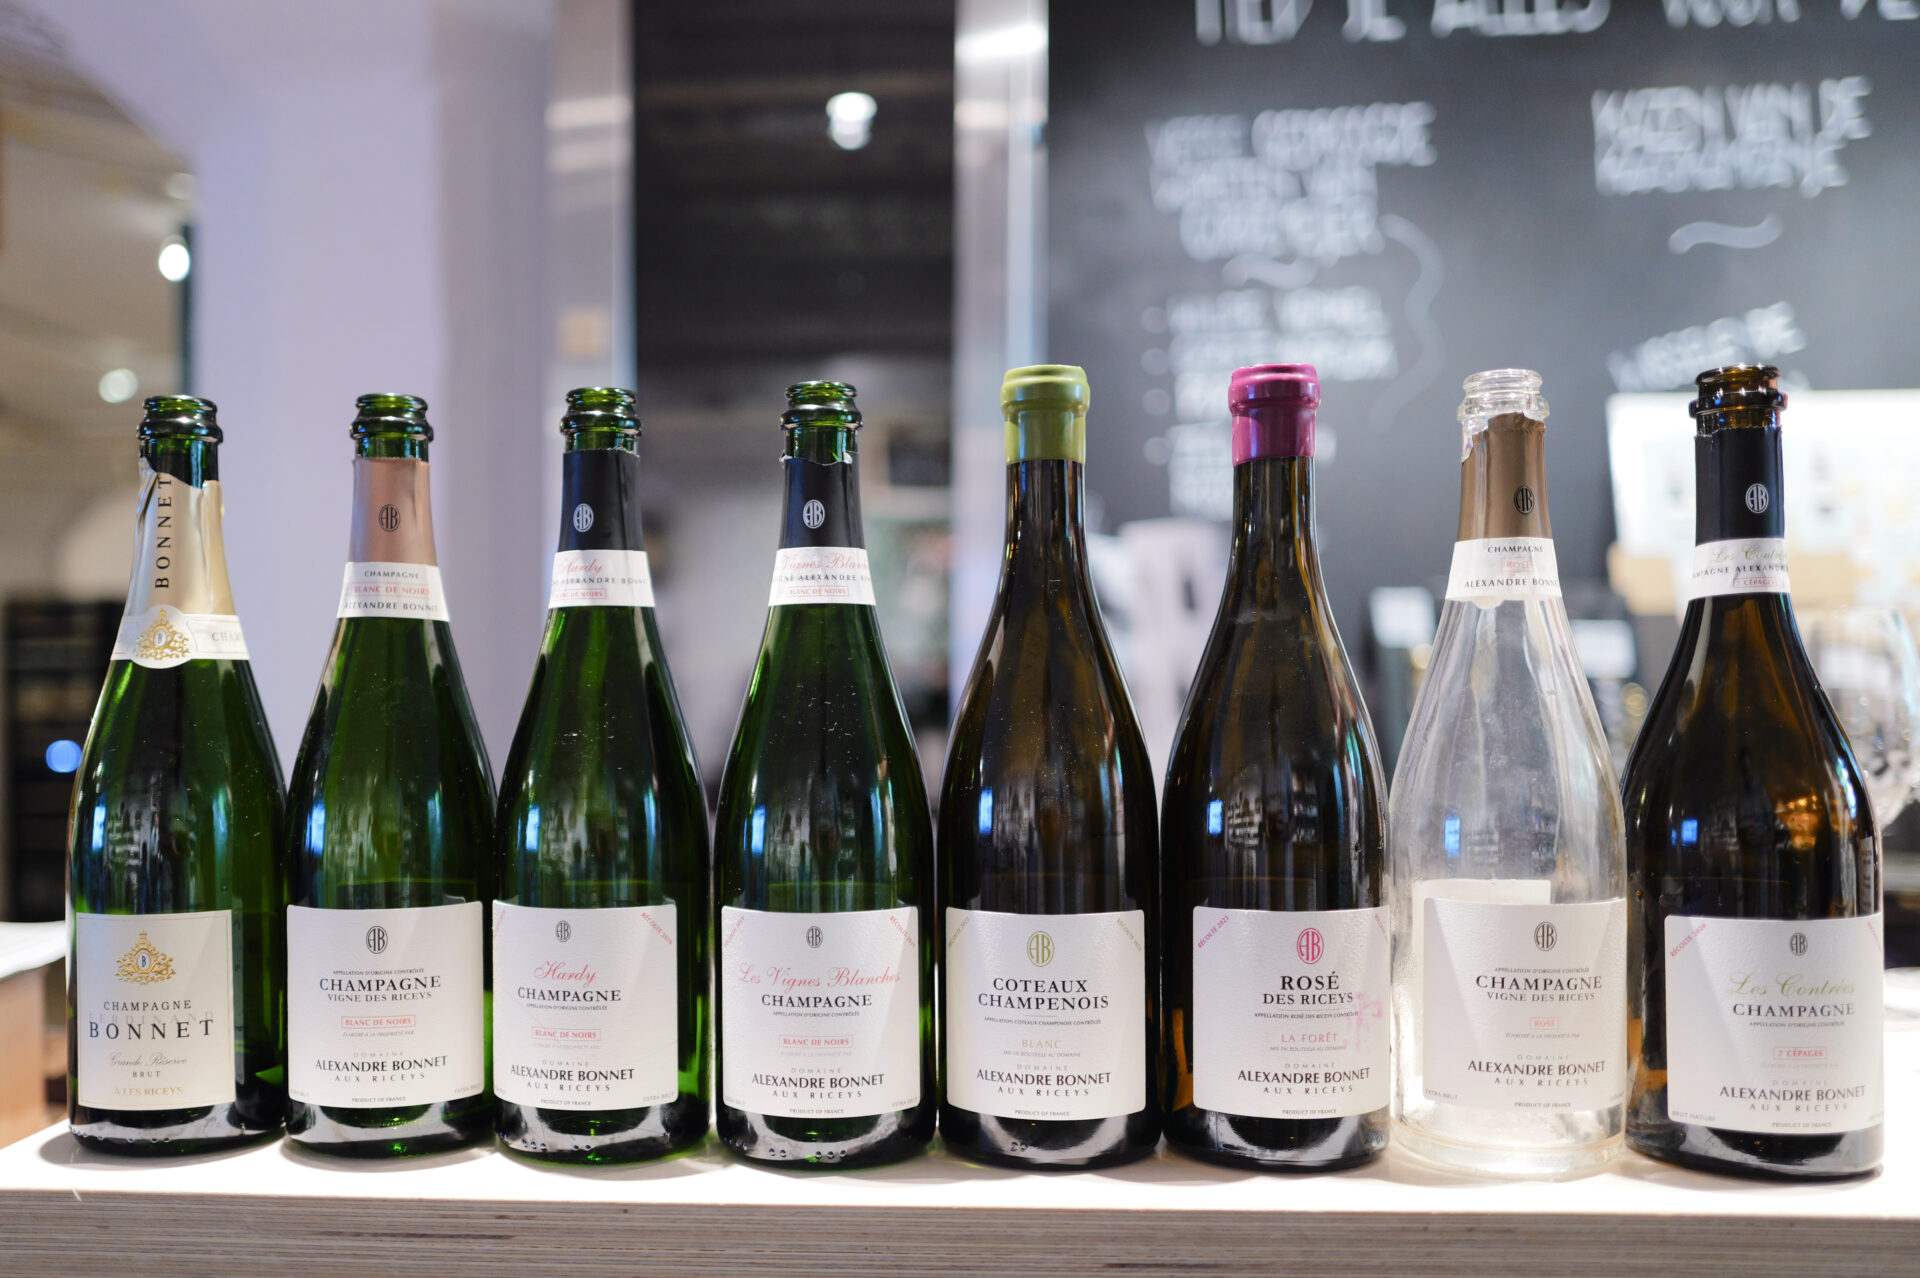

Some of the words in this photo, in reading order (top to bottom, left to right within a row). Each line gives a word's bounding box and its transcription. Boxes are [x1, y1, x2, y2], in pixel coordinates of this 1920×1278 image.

[155, 477, 172, 589] BONNET
[1488, 545, 1543, 553] CHAMPAGNE
[364, 570, 419, 579] CHAMPAGNE
[1464, 578, 1527, 588] ALEXANDRE
[402, 587, 430, 595] NOIRS
[534, 960, 597, 988] Hardy
[738, 962, 760, 984] Les
[767, 967, 821, 993] Vignes
[827, 967, 900, 988] Blanches
[319, 975, 441, 992] CHAMPAGNE
[993, 978, 1088, 993] COTEAUX
[1281, 971, 1340, 991] ROSÉ
[1476, 975, 1602, 991] CHAMPAGNE
[1727, 971, 1768, 996] Les
[1776, 974, 1855, 997] Contrées
[328, 994, 361, 1002] VIGNE
[365, 994, 387, 1002] DES
[391, 991, 432, 1001] RICEYS
[518, 987, 621, 1001] CHAMPAGNE
[1263, 993, 1295, 1005] DES
[1301, 992, 1353, 1005] RICEYS
[1487, 991, 1528, 1001] VIGNE
[1532, 994, 1554, 1002] DES
[1559, 992, 1595, 1001] RICEYS
[104, 1000, 192, 1011] CHAMPAGNE
[761, 994, 872, 1008] CHAMPAGNE
[978, 993, 1109, 1010] CHAMPENOIS
[1733, 1003, 1855, 1017] CHAMPAGNE
[89, 1011, 214, 1024] FERDINAND
[386, 1017, 411, 1025] NOIRS
[89, 1019, 213, 1040] BONNET
[535, 1030, 558, 1038] BLANC
[783, 1038, 808, 1046] BLANC
[824, 1038, 849, 1046] NOIRS
[1282, 1034, 1295, 1043] LA
[1302, 1032, 1338, 1043] FORÊT
[1022, 1040, 1062, 1049] BLANC
[109, 1052, 142, 1066] Grande
[1786, 1048, 1824, 1057] CÉPAGES
[315, 1059, 388, 1072] ALEXANDRE
[392, 1055, 448, 1071] BONNET
[1468, 1060, 1553, 1076] ALEXANDRE
[1558, 1060, 1605, 1075] BONNET
[372, 1073, 425, 1082] RICEYS
[510, 1065, 573, 1081] ALEXANDRE
[578, 1068, 635, 1081] BONNET
[977, 1069, 1052, 1085] ALEXANDRE
[1056, 1072, 1111, 1086] BONNET
[1238, 1070, 1319, 1084] ALEXANDRE
[1324, 1068, 1370, 1083] BONNET
[527, 1082, 549, 1090] AUX
[752, 1073, 825, 1089] ALEXANDRE
[829, 1073, 885, 1088] BONNET
[1494, 1078, 1524, 1086] AUX
[1537, 1078, 1588, 1086] RICEYS
[144, 1087, 184, 1096] RICEYS
[773, 1090, 798, 1098] AUX
[810, 1091, 862, 1099] RICEYS
[998, 1086, 1024, 1095] AUX
[1264, 1086, 1292, 1094] AUX
[1305, 1085, 1353, 1094] RICEYS
[1720, 1086, 1811, 1101] ALEXANDRE
[1817, 1085, 1865, 1100] BONNET
[1749, 1103, 1781, 1112] AUX
[1795, 1102, 1847, 1112] RICEYS
